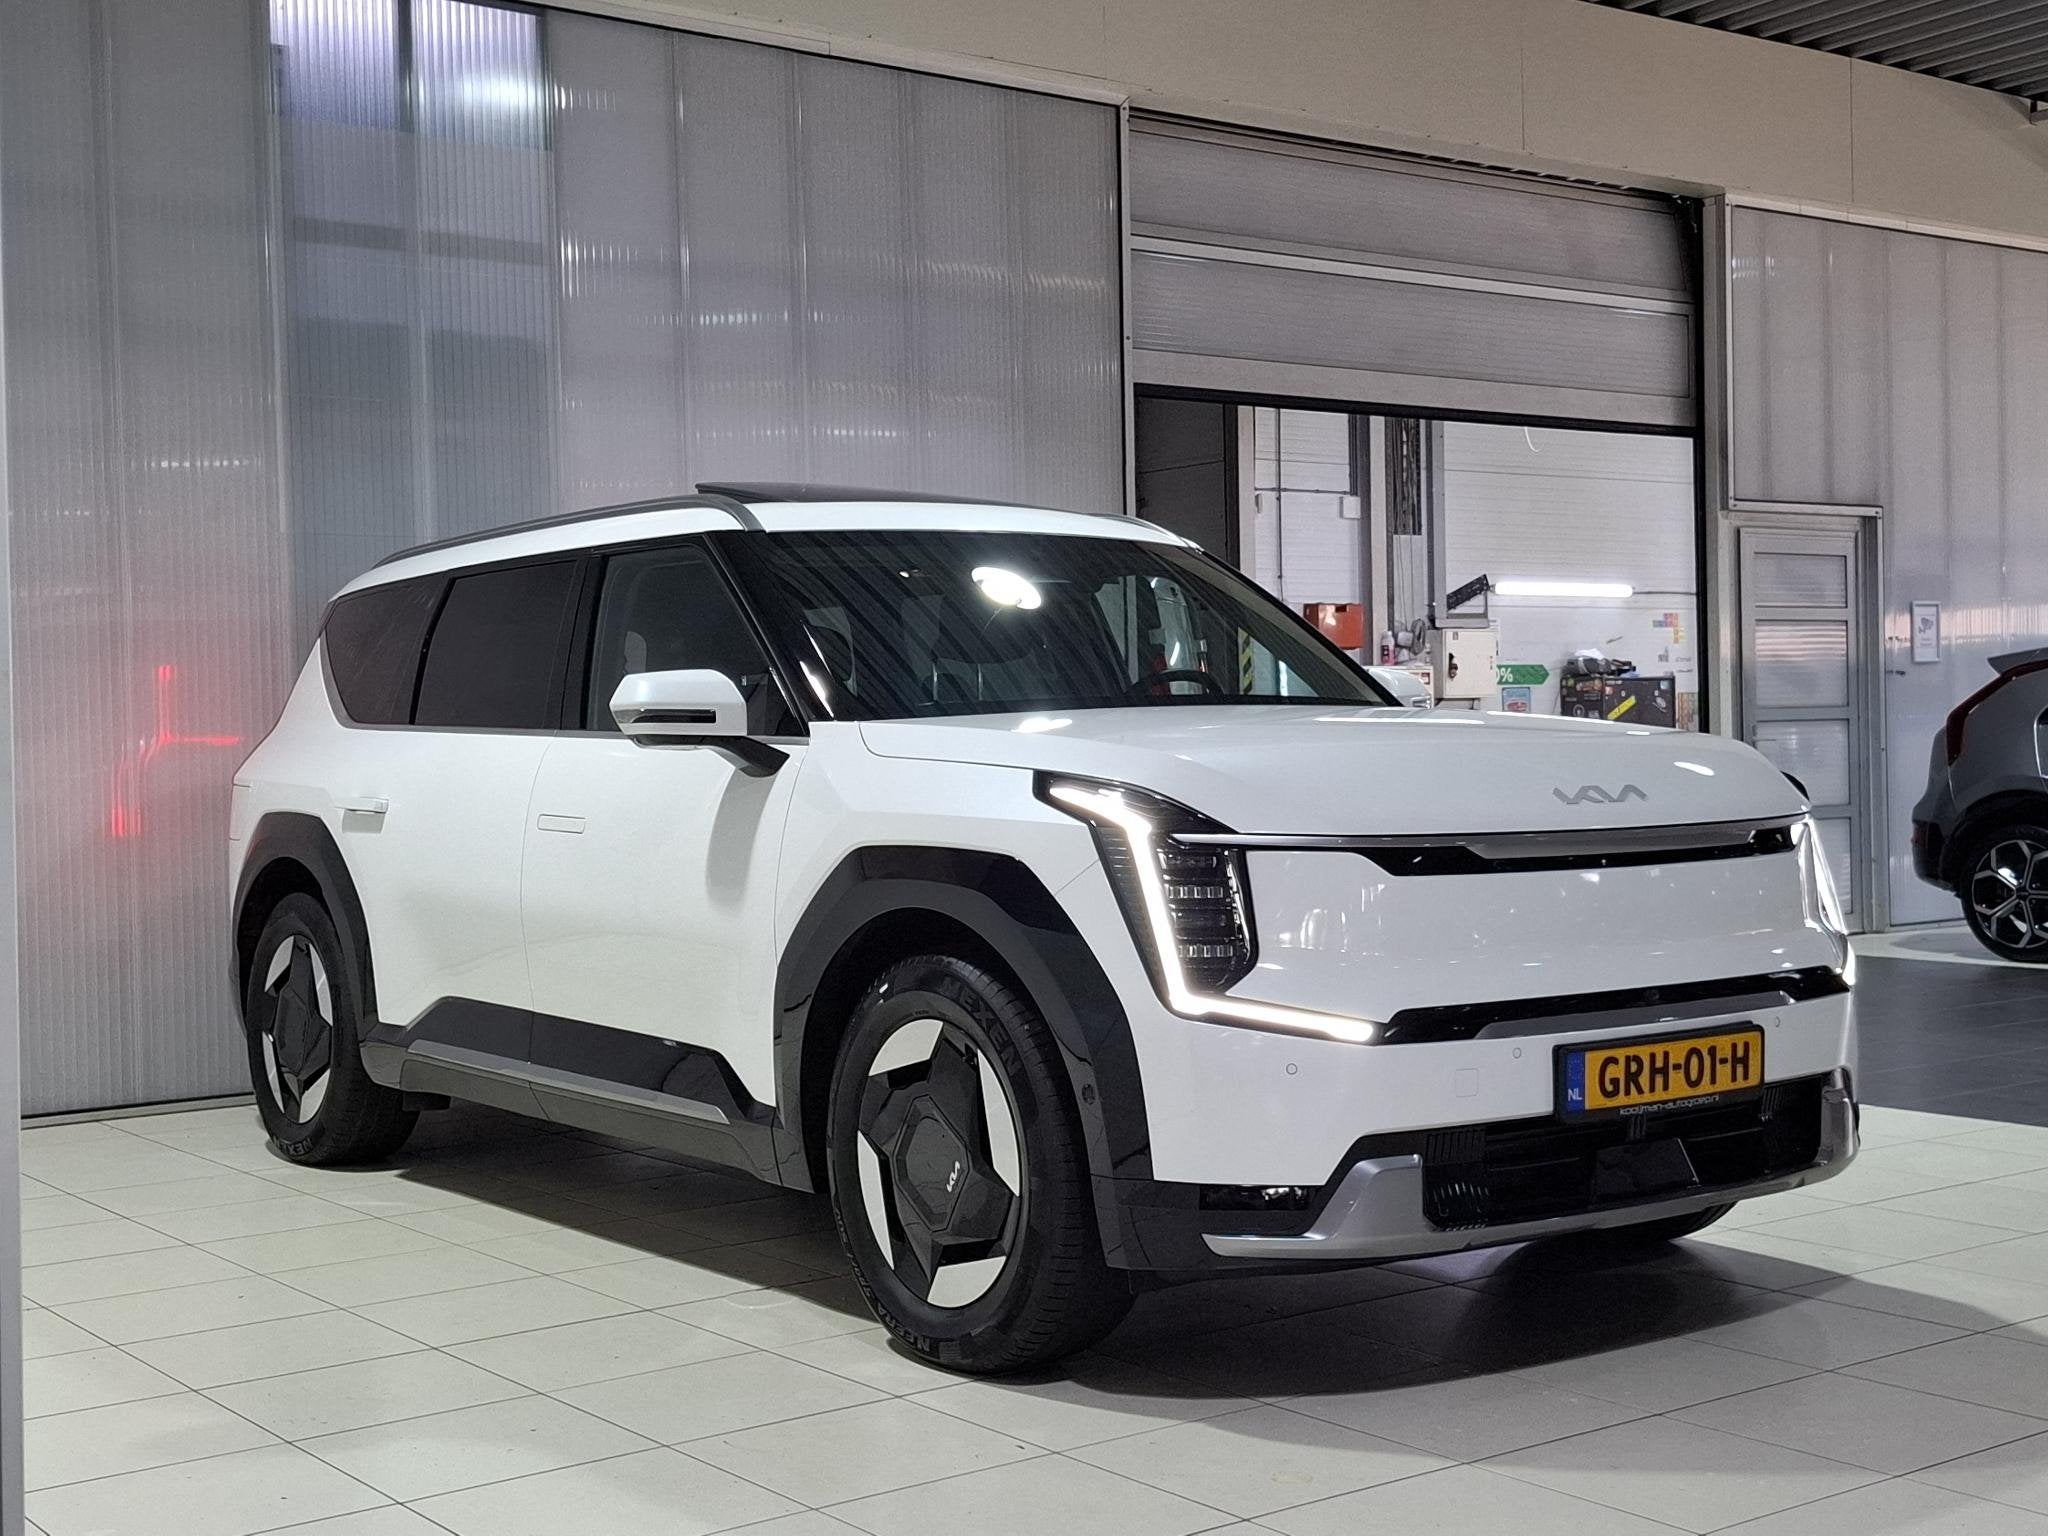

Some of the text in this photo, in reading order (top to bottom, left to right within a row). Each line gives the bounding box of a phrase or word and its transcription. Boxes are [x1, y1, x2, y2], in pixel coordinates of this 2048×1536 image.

[1552, 781, 1648, 804] KIA
[940, 975, 1023, 1079] NEXEN
[1598, 1041, 1750, 1098] GRH-01-H
[1567, 1087, 1583, 1101] NL
